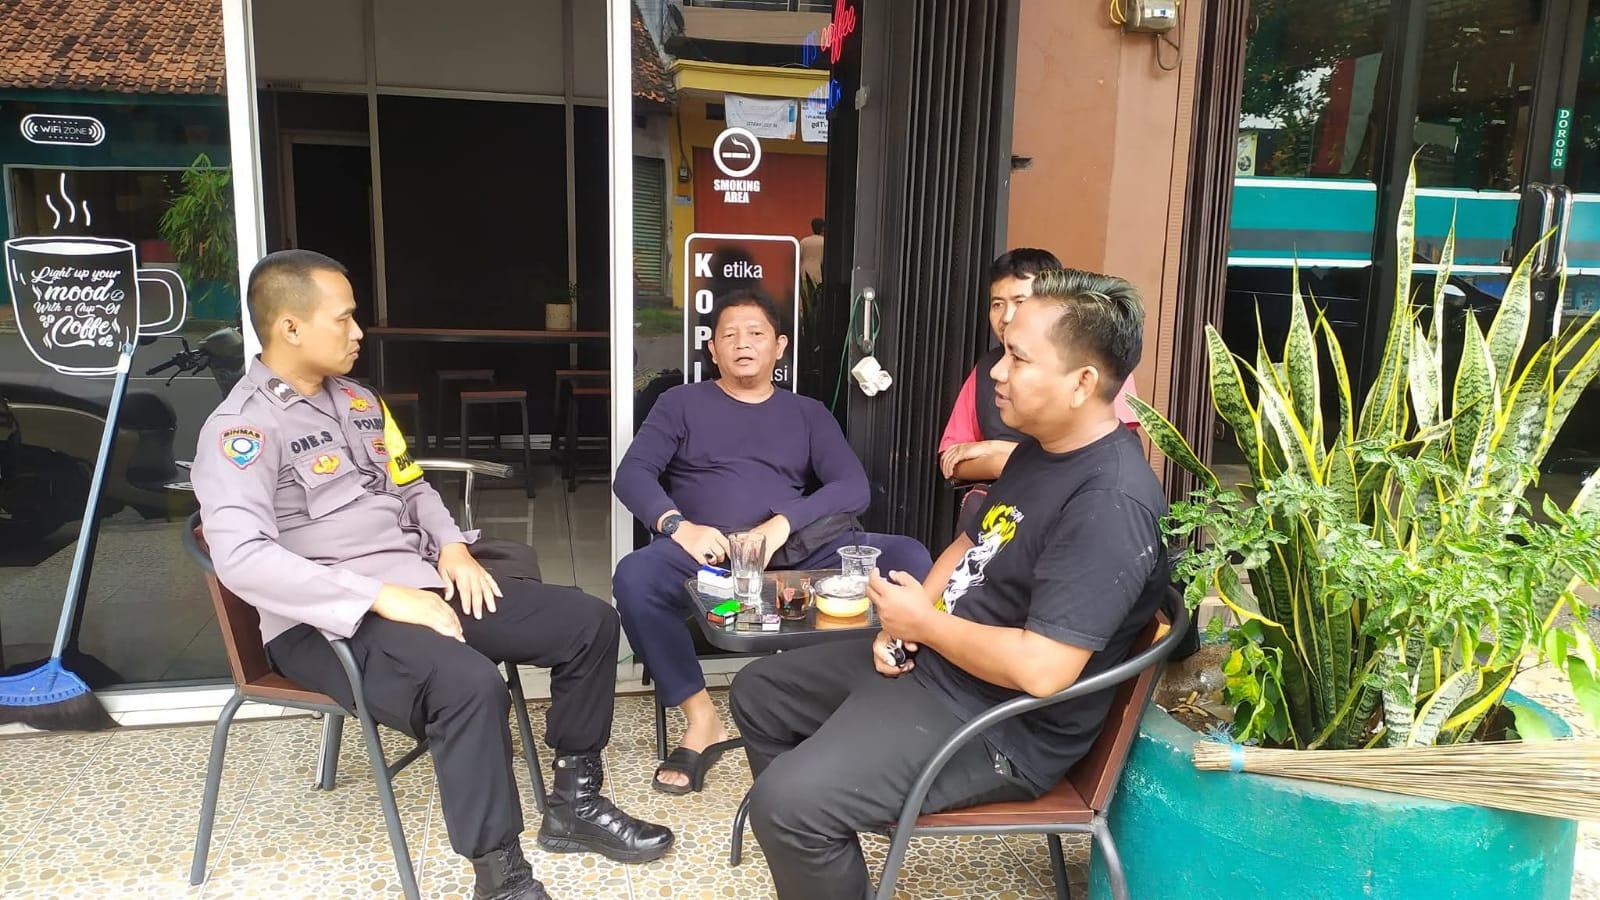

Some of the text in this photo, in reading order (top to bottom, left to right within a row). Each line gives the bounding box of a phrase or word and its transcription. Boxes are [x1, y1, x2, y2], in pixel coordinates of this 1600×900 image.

[39, 124, 88, 135] WiFi ZONE
[1553, 109, 1570, 167] DORONG
[713, 179, 761, 193] SMOKING
[723, 191, 750, 204] AREA
[31, 266, 122, 284] Light up your
[44, 279, 115, 302] mood
[33, 301, 121, 318] With a Cup Of
[51, 315, 112, 348] Coffe
[223, 427, 261, 438] BINMAS
